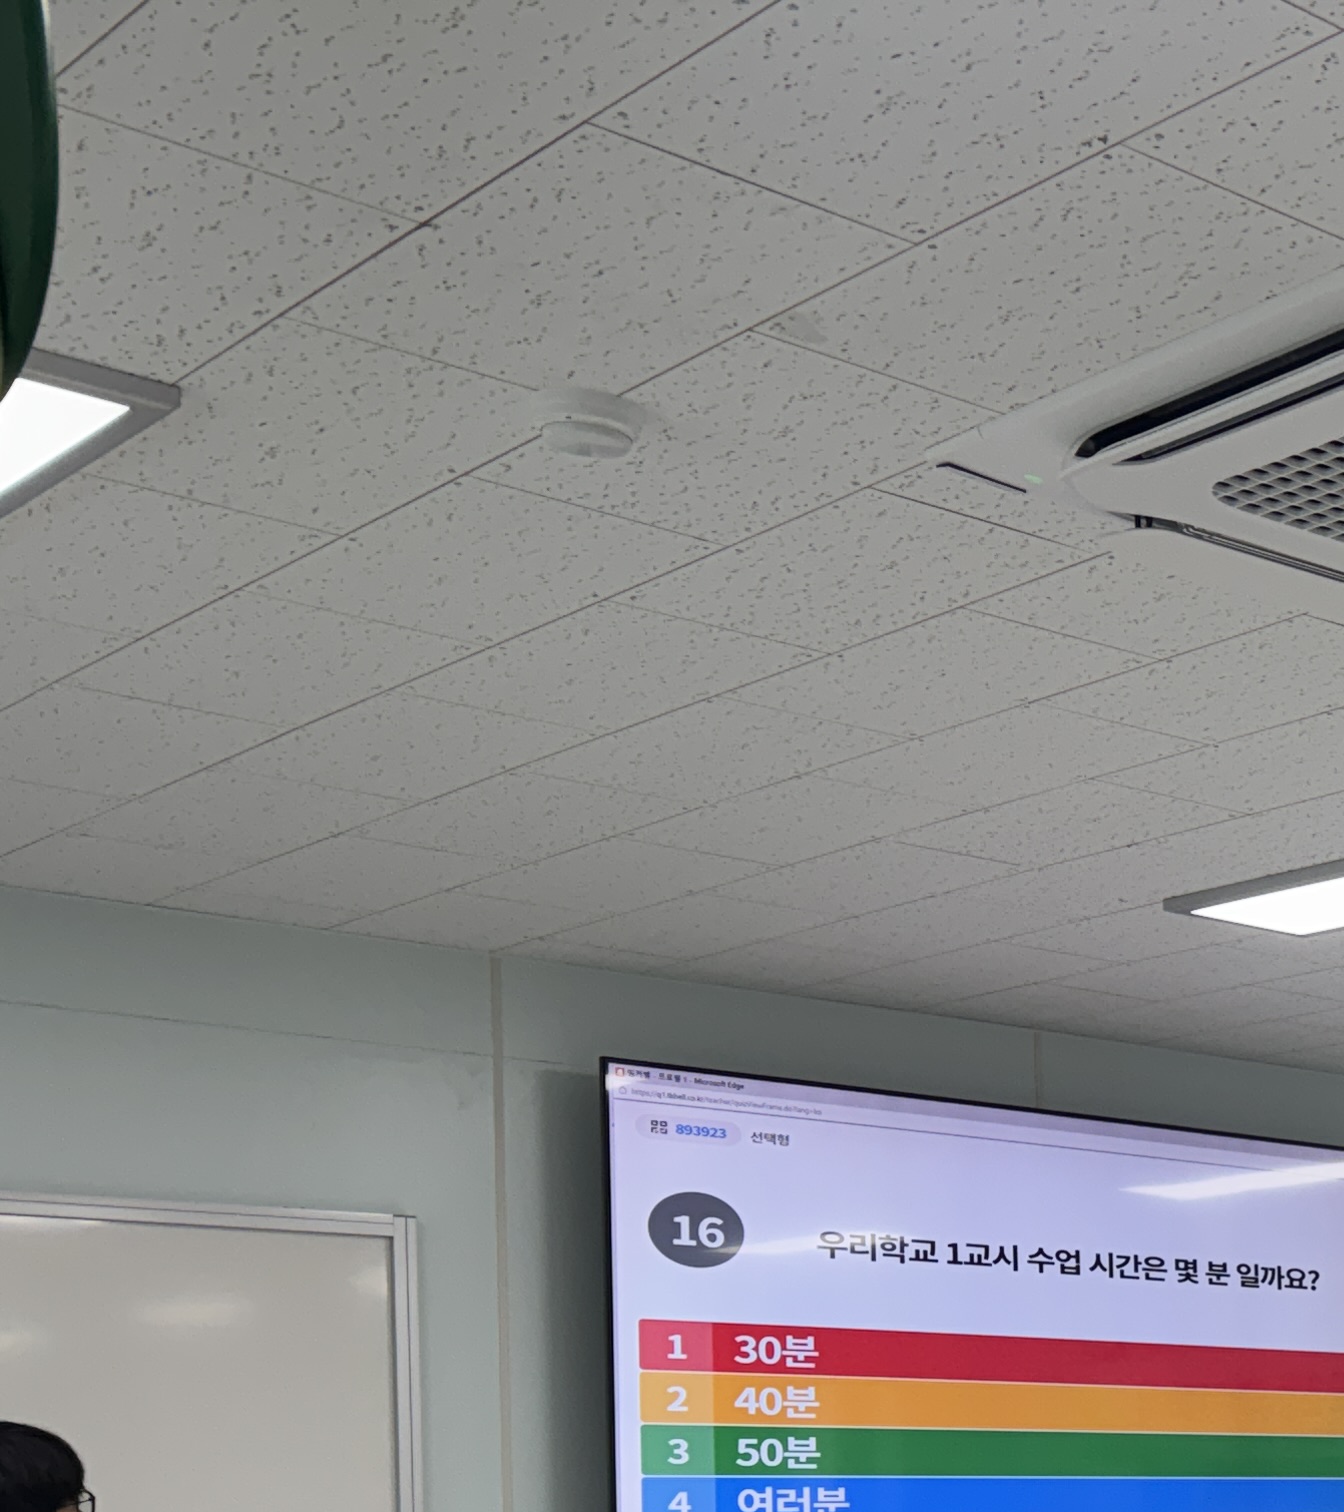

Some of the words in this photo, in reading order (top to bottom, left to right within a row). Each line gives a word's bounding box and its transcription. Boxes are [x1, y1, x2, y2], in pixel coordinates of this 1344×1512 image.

[693, 1078, 726, 1087] Microsoft
[727, 1081, 744, 1091] Edge
[675, 1124, 727, 1139] 893923
[750, 1131, 790, 1147] 선택형
[672, 1215, 725, 1248] 16
[817, 1231, 939, 1264] 우리학교
[946, 1242, 1019, 1272] 1교시
[1026, 1247, 1081, 1276] 수업
[1088, 1252, 1168, 1282] 시간은
[1174, 1258, 1199, 1284] 몇
[1205, 1261, 1231, 1286] 분
[1236, 1263, 1320, 1291] 일까요?
[667, 1333, 688, 1360] 1
[733, 1335, 820, 1369] 30분
[666, 1386, 689, 1412] 2
[733, 1385, 820, 1419] 40분
[667, 1438, 690, 1465] 3
[735, 1437, 821, 1470] 50분
